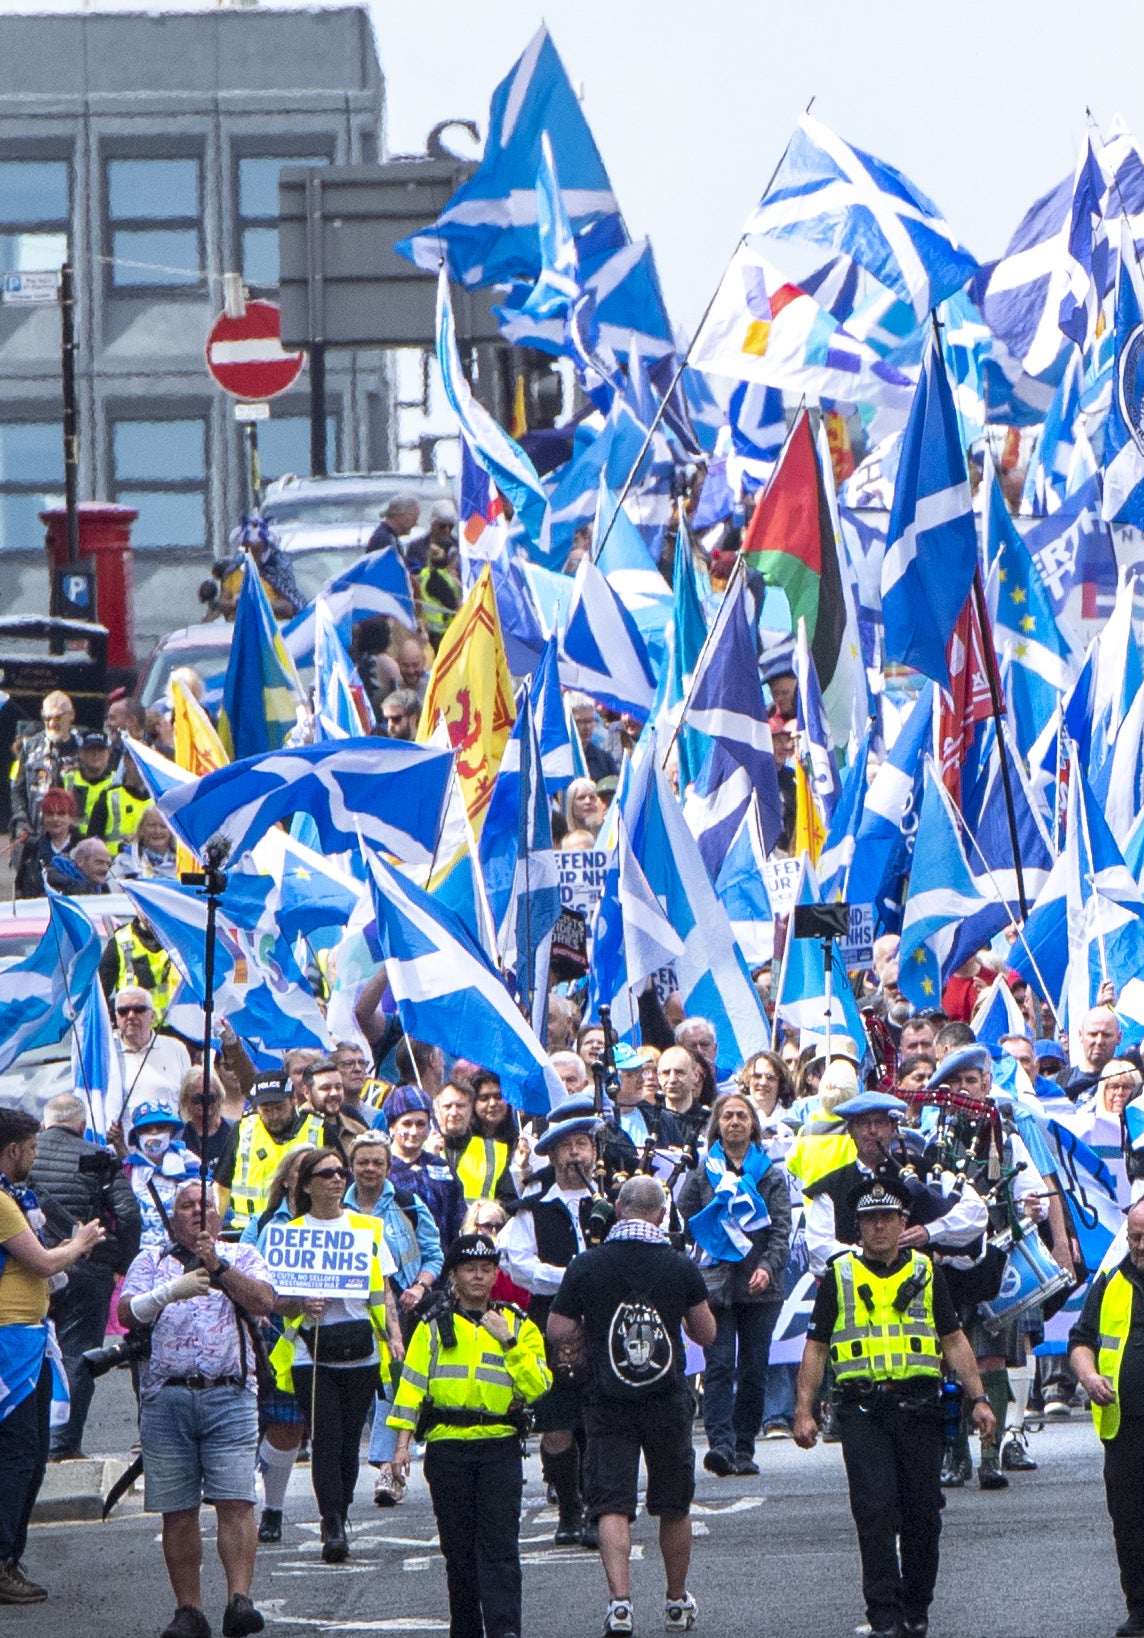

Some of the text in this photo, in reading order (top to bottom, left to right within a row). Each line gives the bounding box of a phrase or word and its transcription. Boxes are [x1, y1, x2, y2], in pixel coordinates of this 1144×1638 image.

[554, 851, 607, 870] EFEND
[582, 870, 608, 887] NH
[269, 1227, 355, 1250] DEFEND
[268, 1247, 369, 1272] OUR NHS
